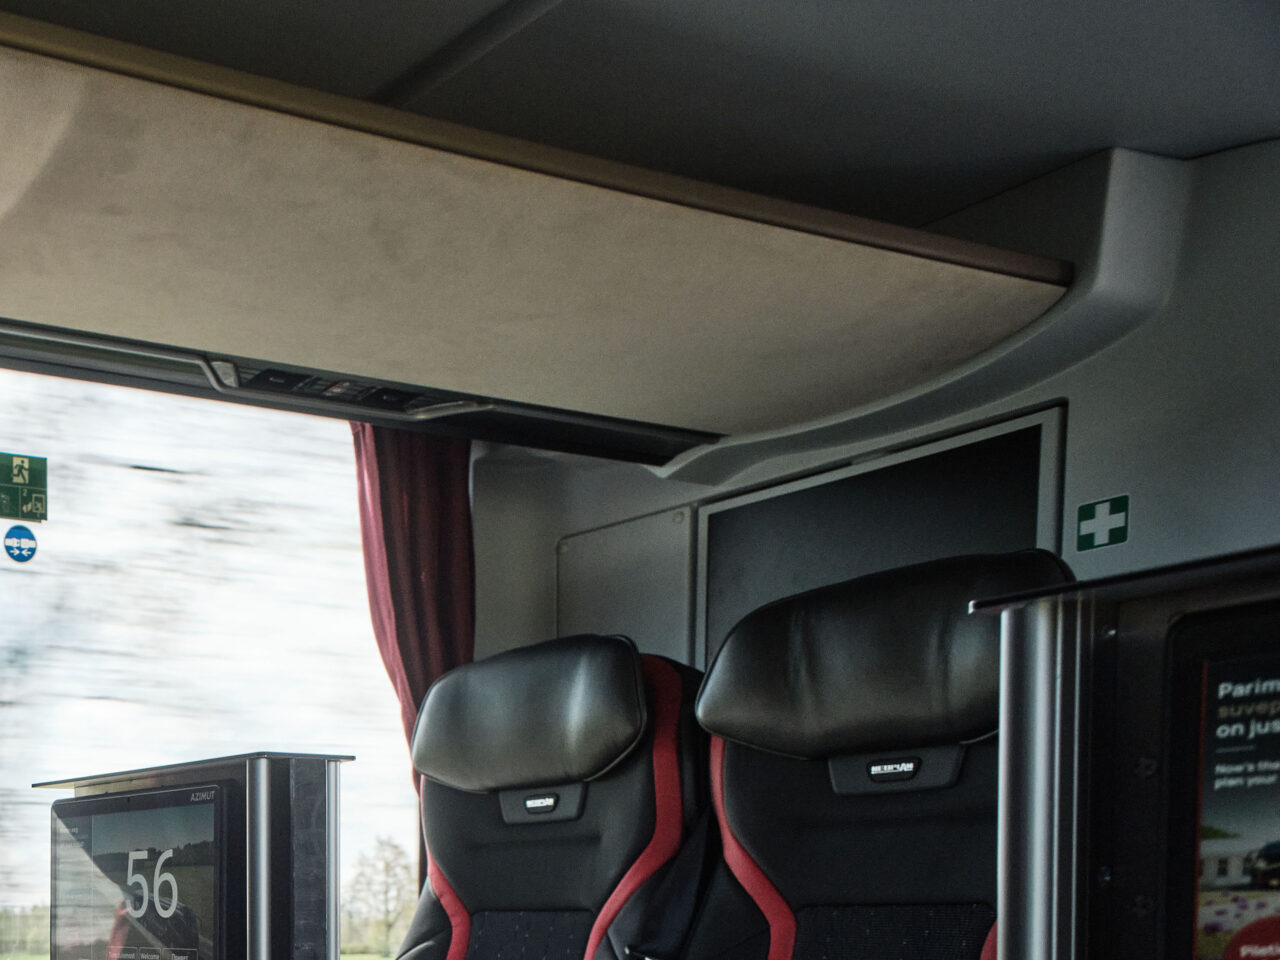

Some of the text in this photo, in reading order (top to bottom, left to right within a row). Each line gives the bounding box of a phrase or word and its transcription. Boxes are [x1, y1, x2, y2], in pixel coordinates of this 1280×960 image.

[1216, 723, 1245, 739] on
[190, 790, 215, 802] AZIMUT
[125, 848, 178, 919] 56
